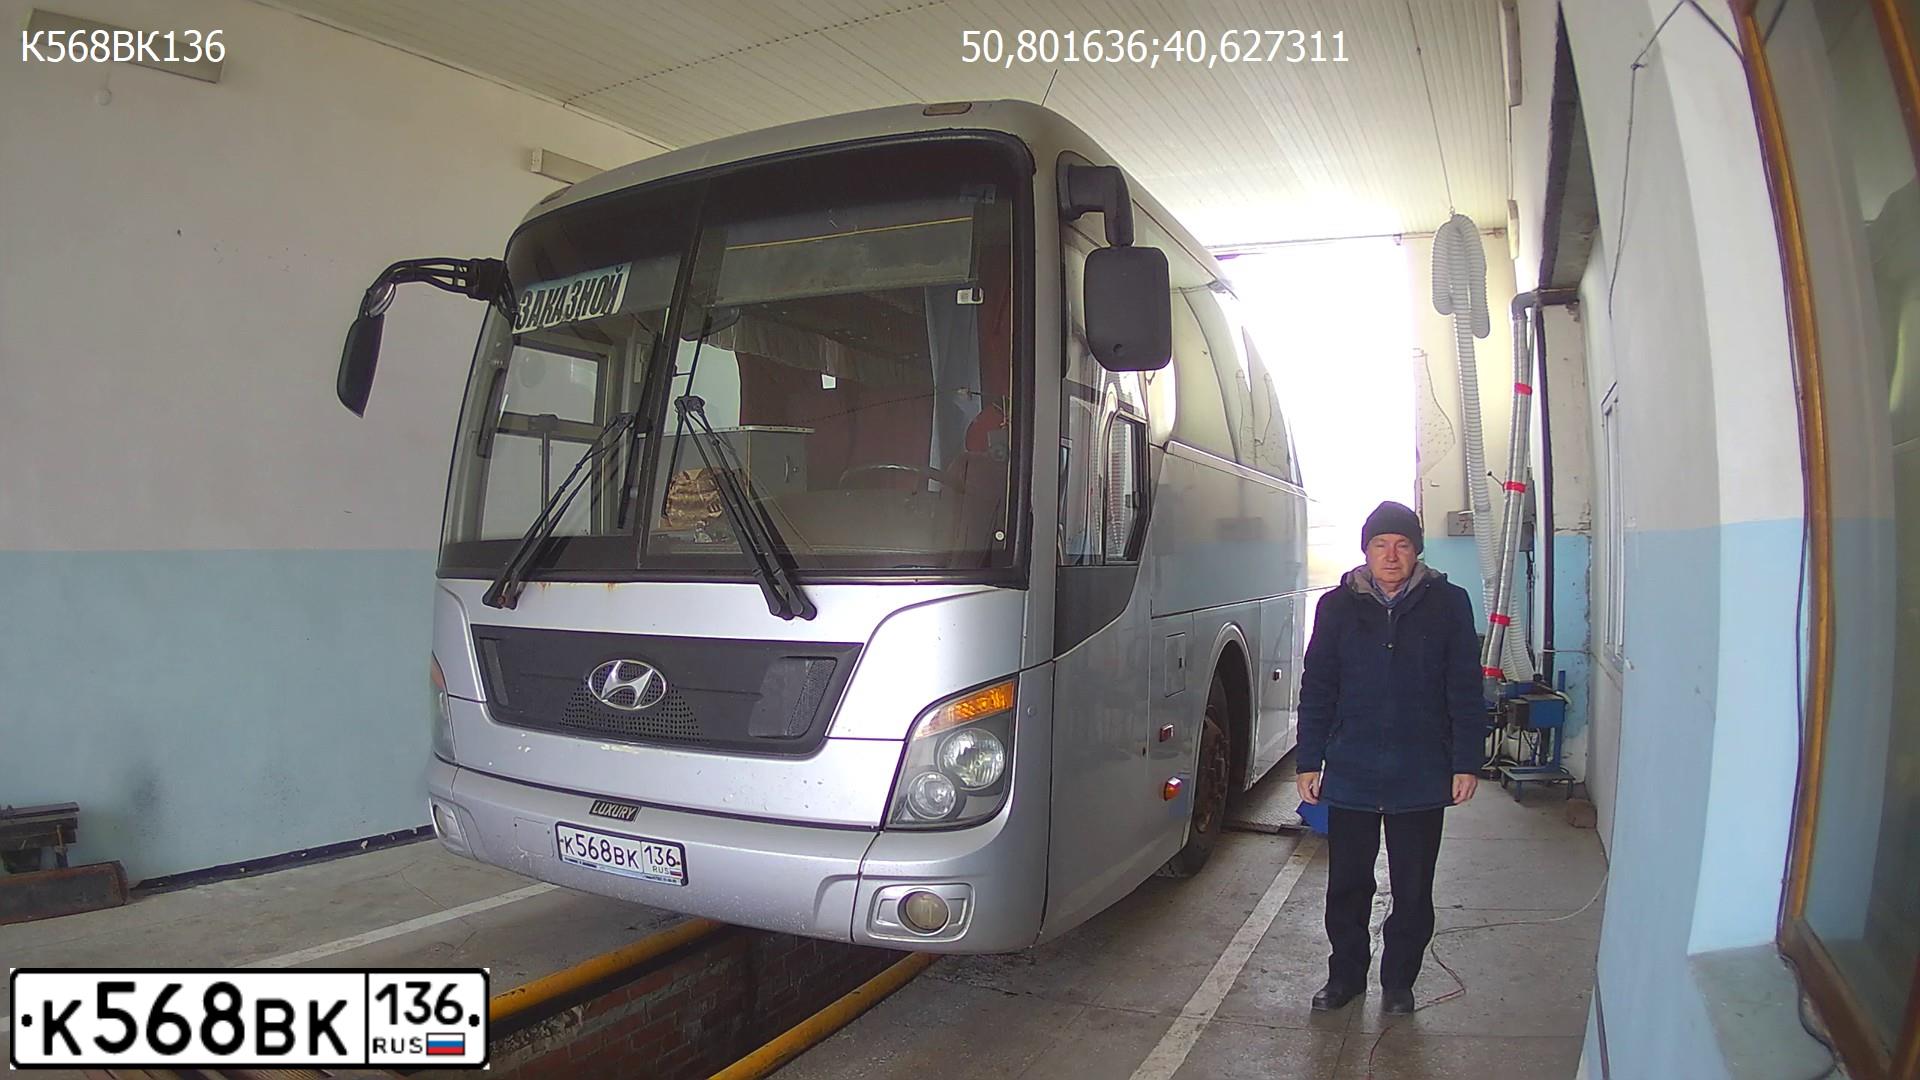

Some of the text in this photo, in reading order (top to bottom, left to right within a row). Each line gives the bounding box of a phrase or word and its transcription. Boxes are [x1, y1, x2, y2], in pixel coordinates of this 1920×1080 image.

[516, 265, 624, 330] ЗАКАЗНОЙ
[591, 802, 637, 820] LUXURY
[644, 845, 677, 867] 136
[652, 865, 670, 875] RUS
